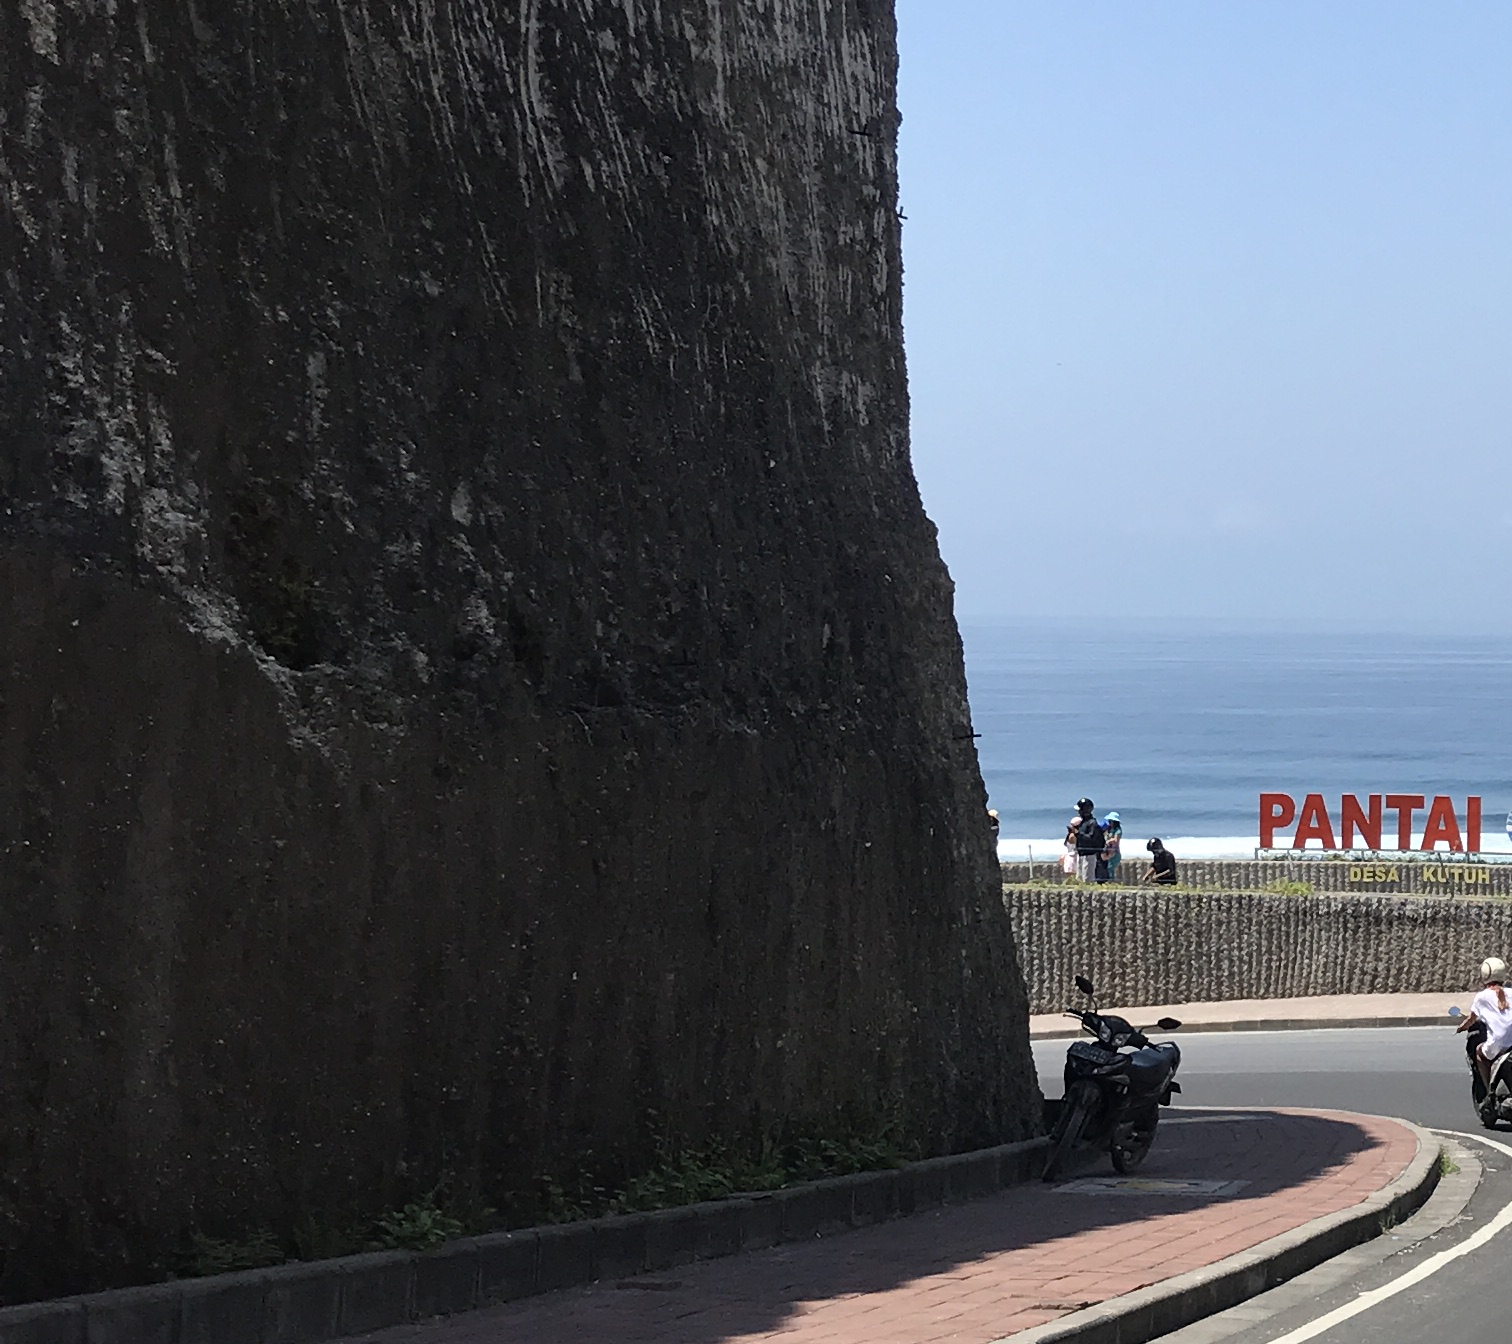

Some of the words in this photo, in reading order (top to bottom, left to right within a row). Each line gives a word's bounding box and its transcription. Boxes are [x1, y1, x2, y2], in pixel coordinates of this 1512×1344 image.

[1259, 793, 1481, 853] PANTAI
[1350, 866, 1400, 882] DESA
[1422, 866, 1490, 885] KUTUH
